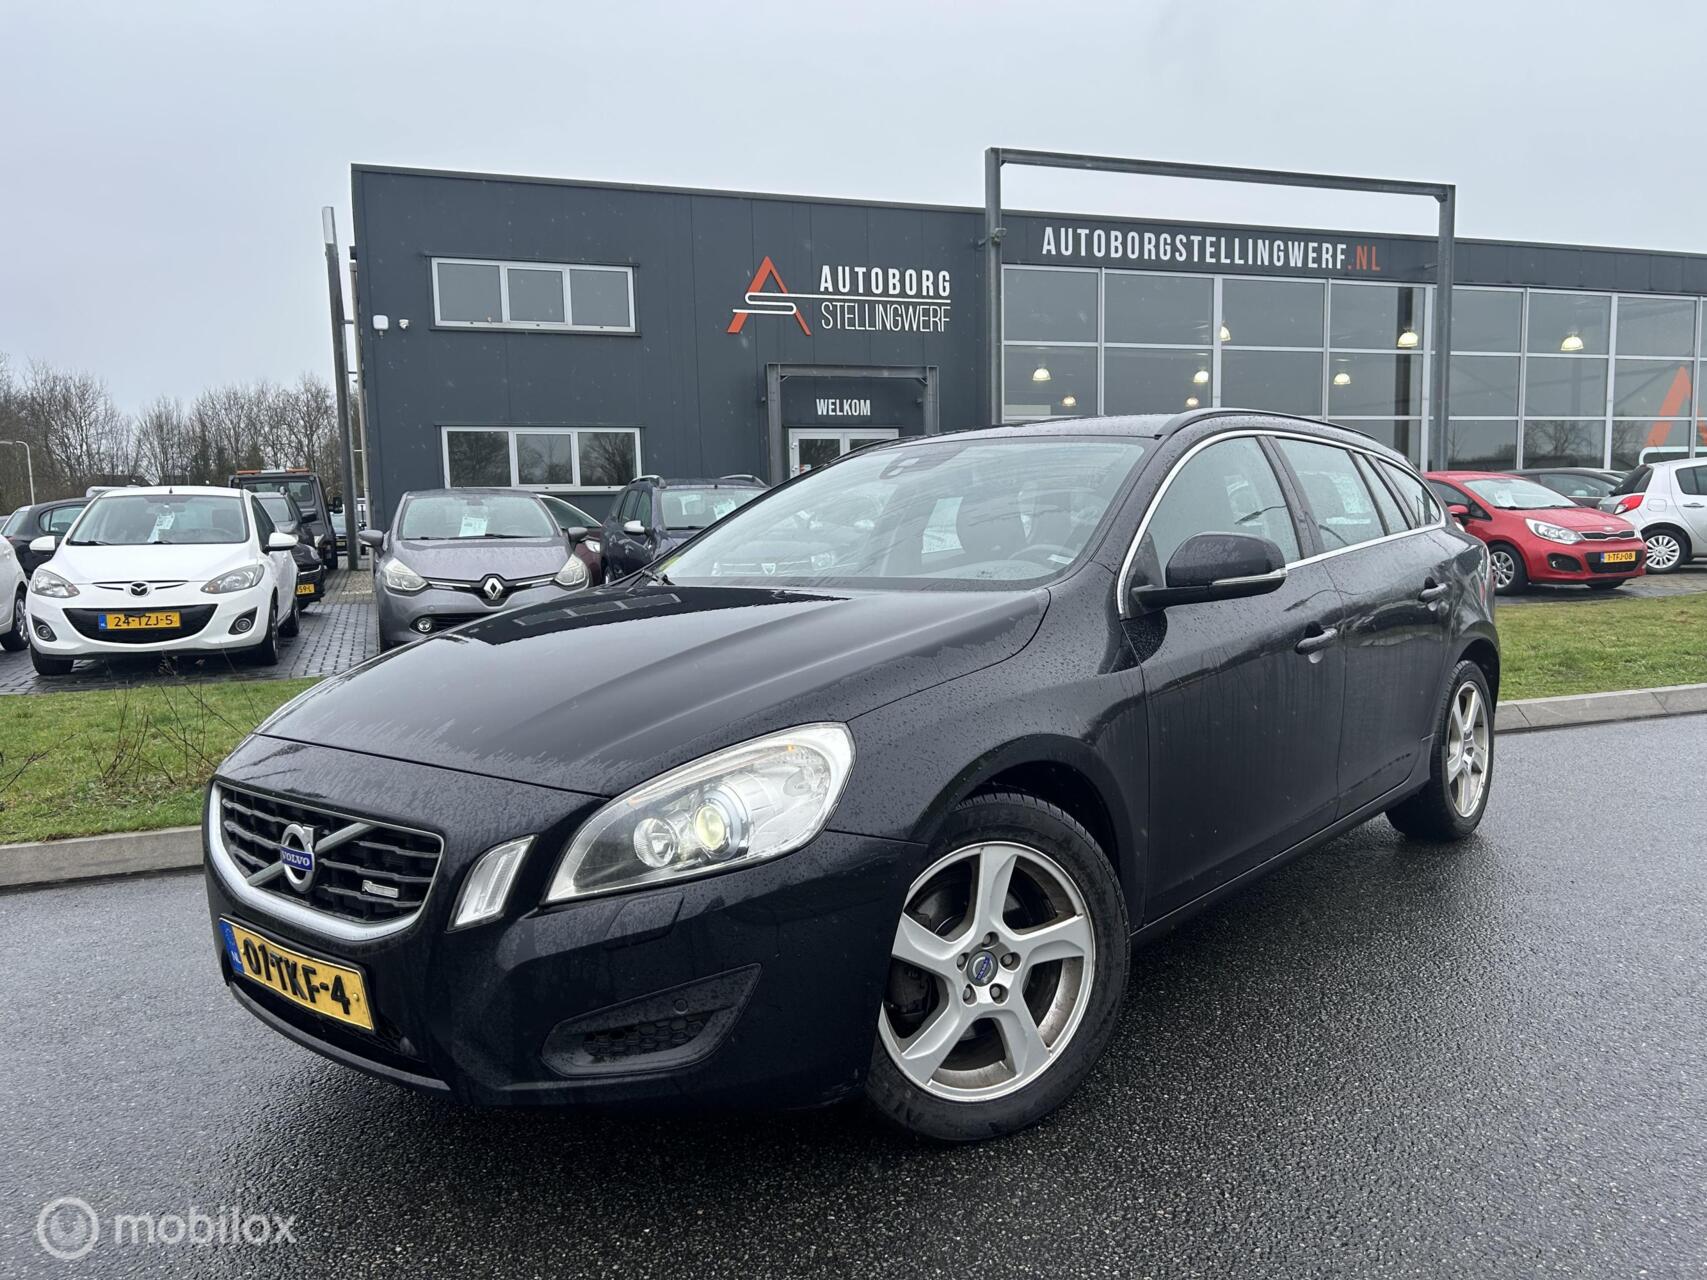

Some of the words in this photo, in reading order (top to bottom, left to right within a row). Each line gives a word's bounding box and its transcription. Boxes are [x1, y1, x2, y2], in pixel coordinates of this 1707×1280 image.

[1042, 226, 1381, 272] AUTOBORGSTELLINGWERF.NL
[820, 265, 950, 297] AUTOBORG
[821, 302, 951, 333] STELLINGWERF
[816, 398, 871, 416] WELKOM
[113, 614, 173, 627] 24-TZJ-5
[281, 850, 310, 866] VOLVO
[242, 937, 351, 1015] 01-TKF-4
